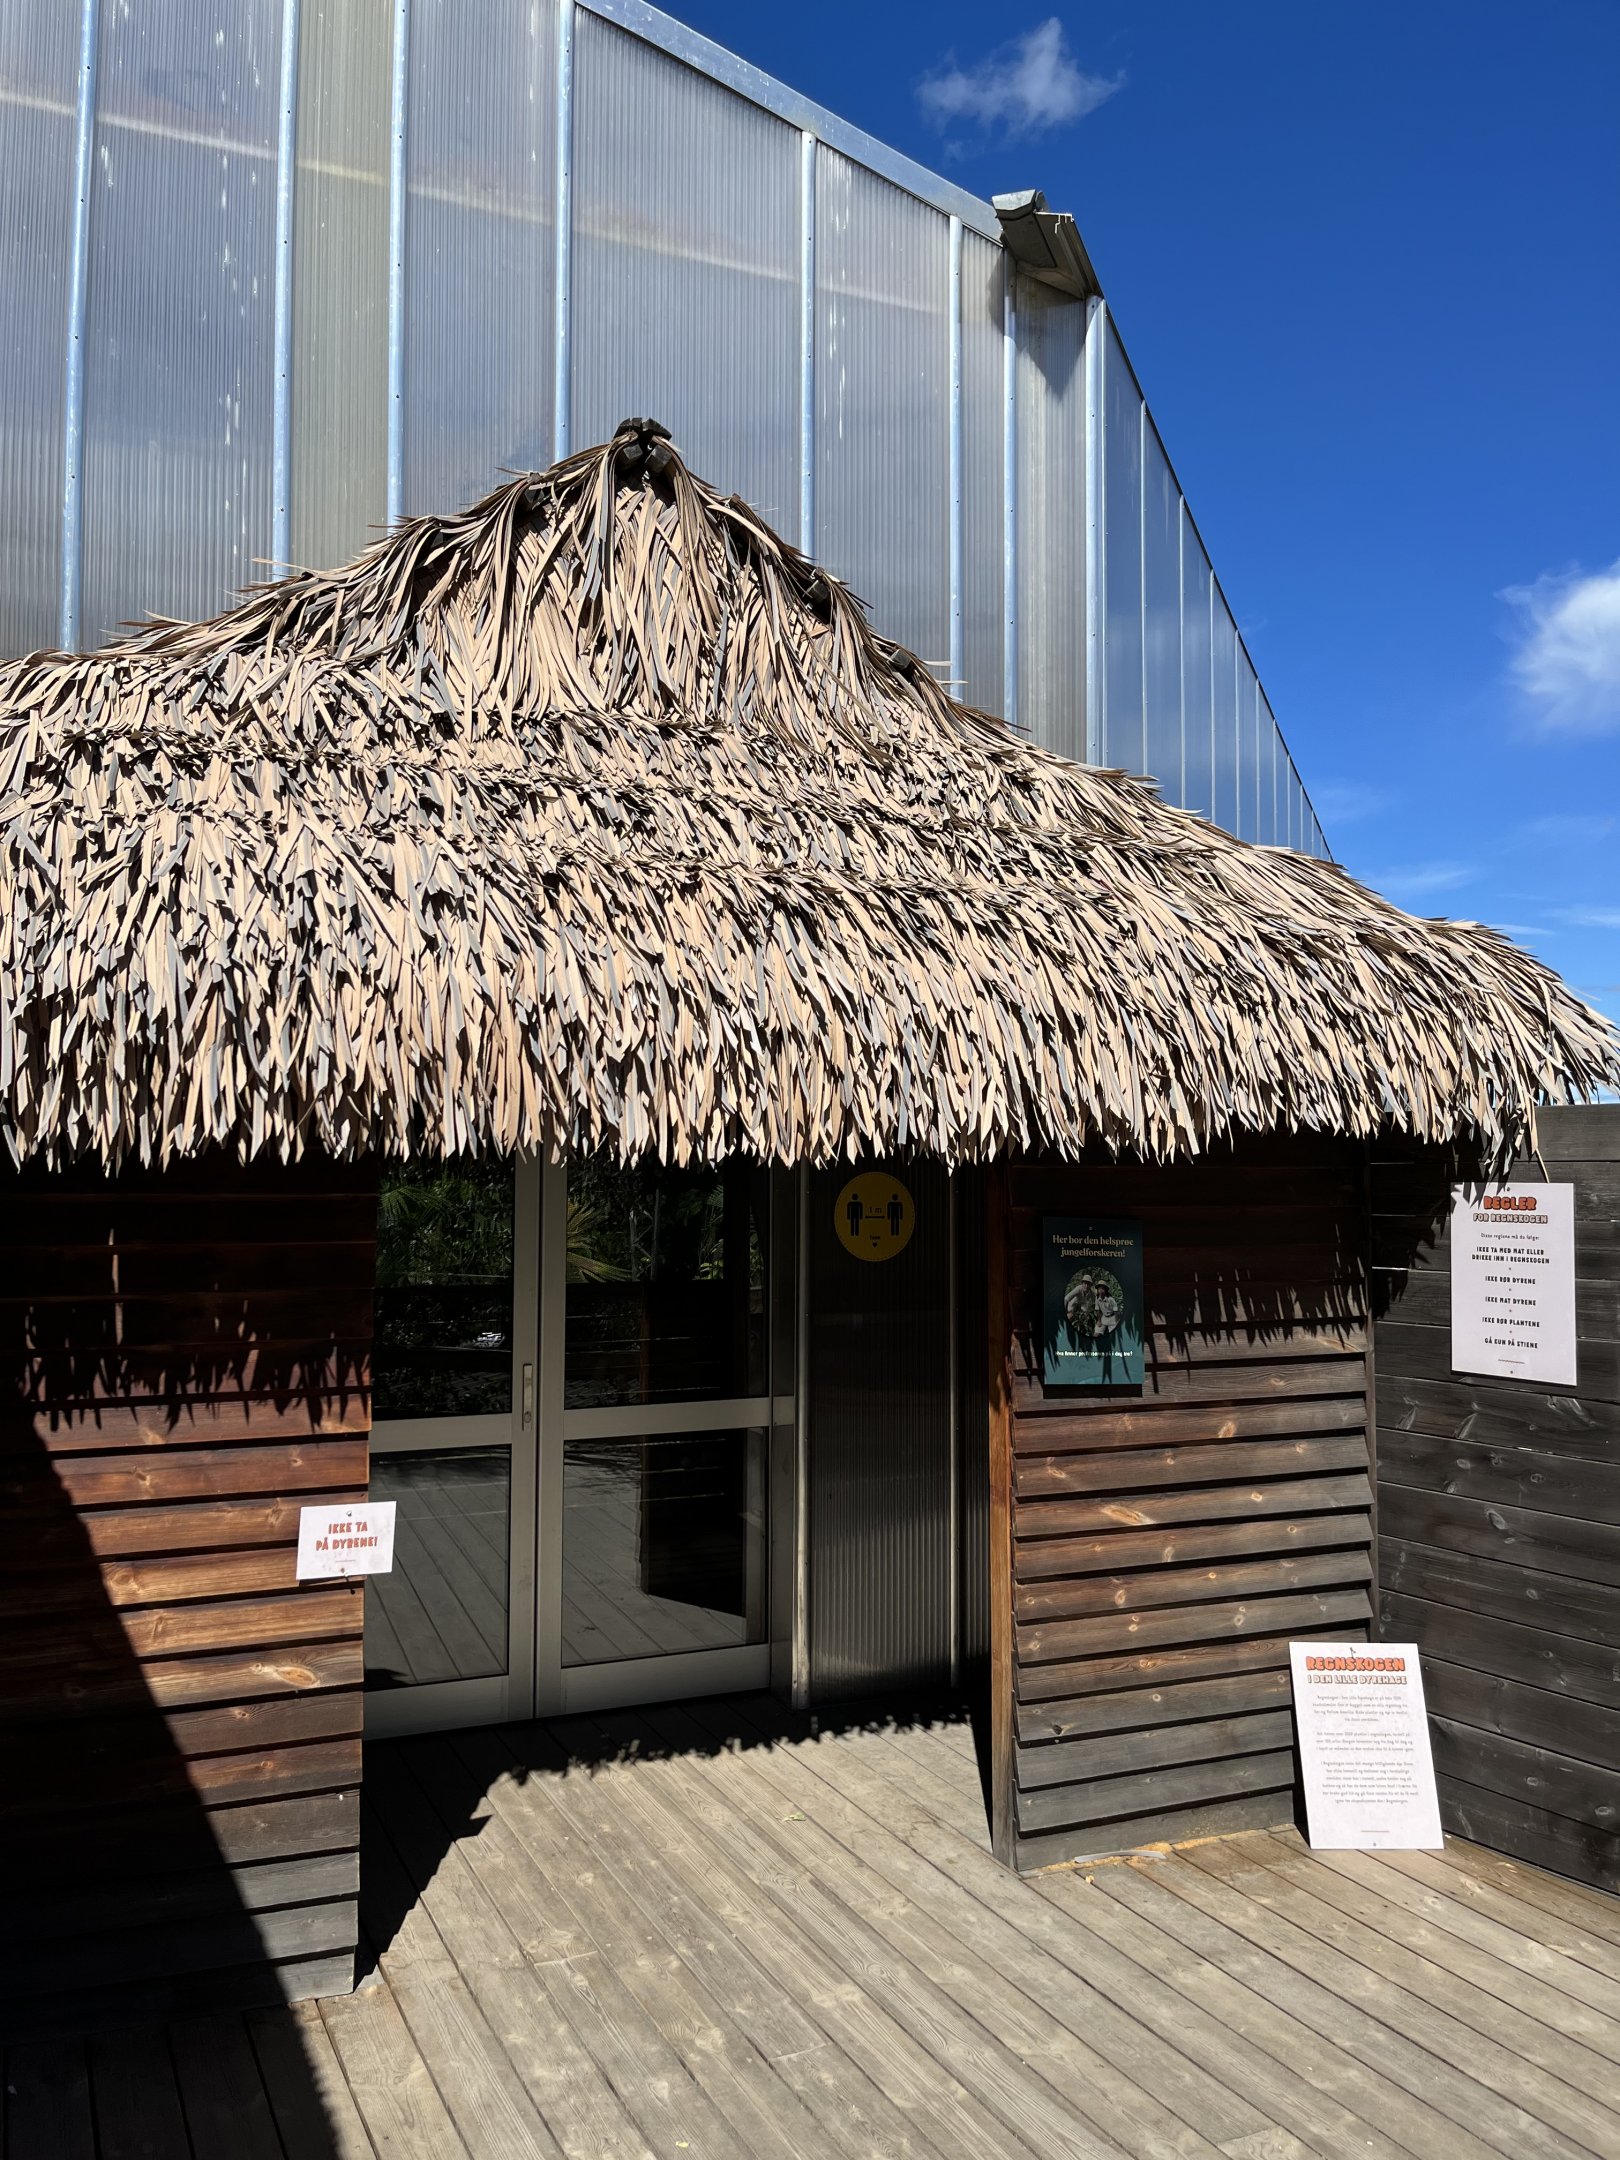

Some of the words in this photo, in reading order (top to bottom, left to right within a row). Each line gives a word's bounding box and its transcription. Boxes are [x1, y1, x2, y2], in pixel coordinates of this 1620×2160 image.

[1483, 1196, 1537, 1211] REGLER
[1473, 1213, 1489, 1222] FOR
[1490, 1213, 1548, 1224] REGNSKOGEN
[1052, 1234, 1068, 1244] Her
[1068, 1235, 1084, 1244] bor
[1084, 1236, 1099, 1245] den
[1099, 1236, 1134, 1247] helsprøe
[1060, 1247, 1126, 1257] jungelforskeren!
[1510, 1256, 1550, 1264] REGNSKOGEN
[1512, 1298, 1536, 1306] DYRENE
[1509, 1319, 1540, 1327] PLANTENE
[1484, 1336, 1492, 1344] GÅ
[1507, 1338, 1515, 1346] PÅ
[1516, 1341, 1538, 1349] STIENE
[328, 1522, 352, 1534] IKKE
[355, 1521, 368, 1532] TA
[316, 1537, 329, 1551] PÅ
[332, 1536, 378, 1550] DYRENE!
[1306, 1656, 1405, 1671] REGNSKOGEN
[1313, 1674, 1333, 1684] DEN
[1334, 1675, 1358, 1684] LILLE
[1359, 1675, 1408, 1685] DYREHAGE
